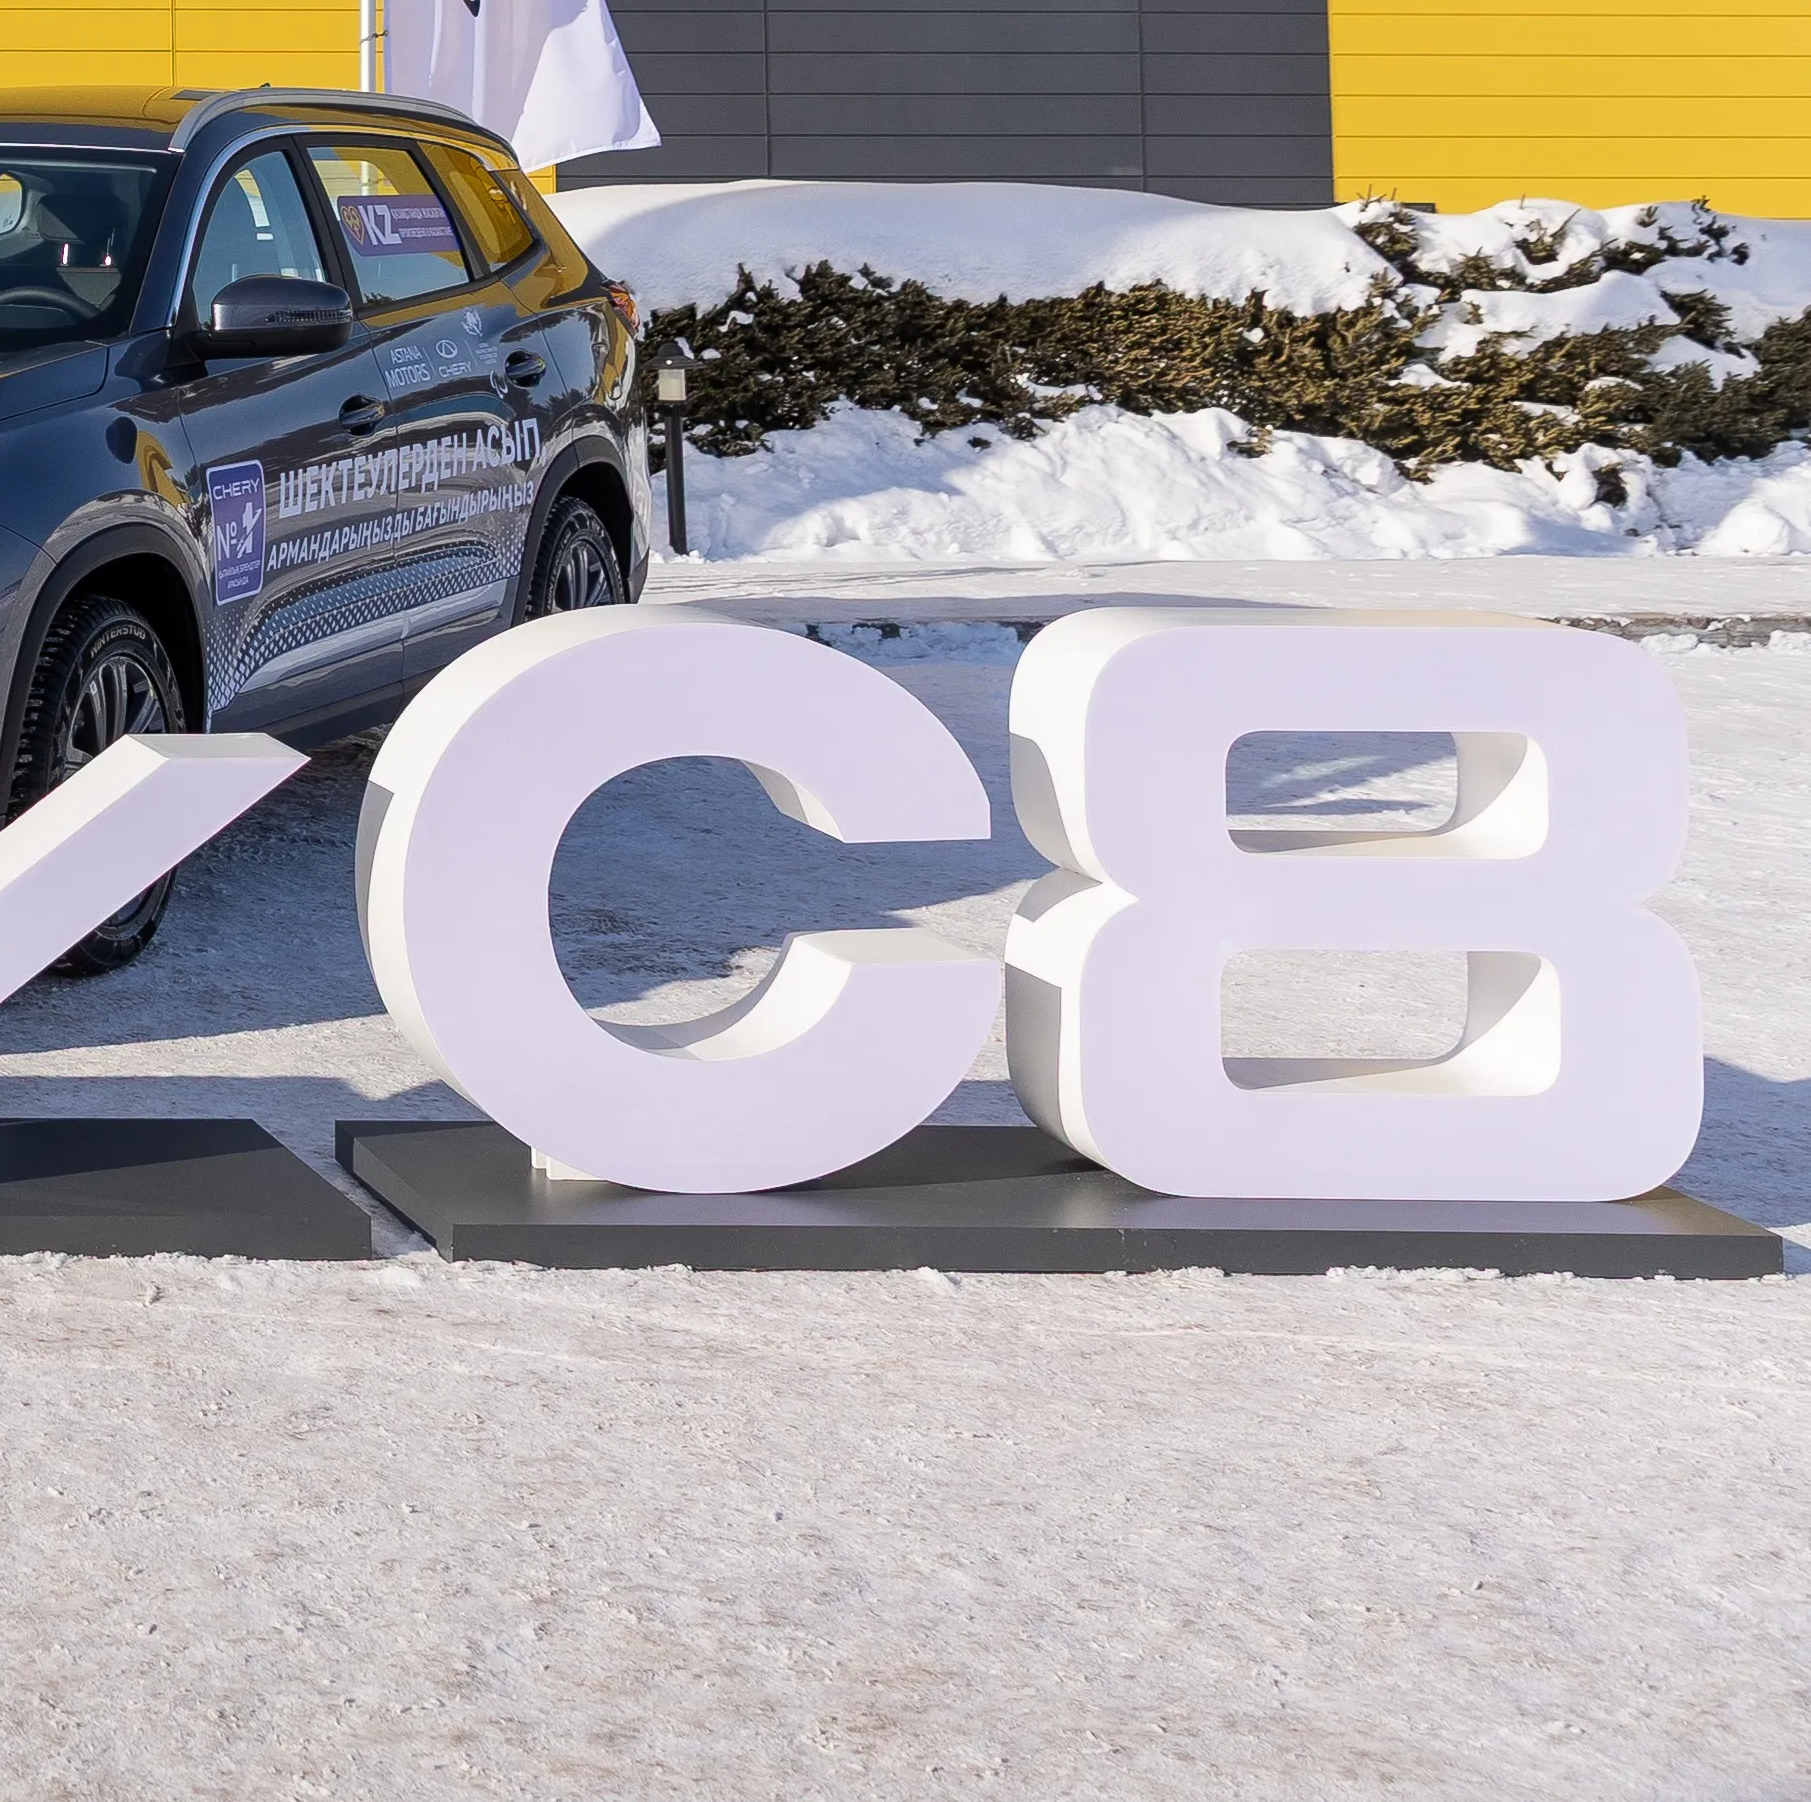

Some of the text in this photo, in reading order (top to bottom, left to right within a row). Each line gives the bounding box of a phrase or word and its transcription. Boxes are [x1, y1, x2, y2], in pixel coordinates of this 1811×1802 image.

[358, 204, 402, 245] KZ
[389, 345, 423, 365] ASTANA
[384, 363, 431, 388] MOTORS
[438, 360, 473, 378] CHERY
[279, 432, 467, 520] ШЕКТЕУЛЕРДЕН
[212, 477, 260, 501] CHERY
[267, 509, 415, 572] АРМАНДАРЫҢЫЗДЫ
